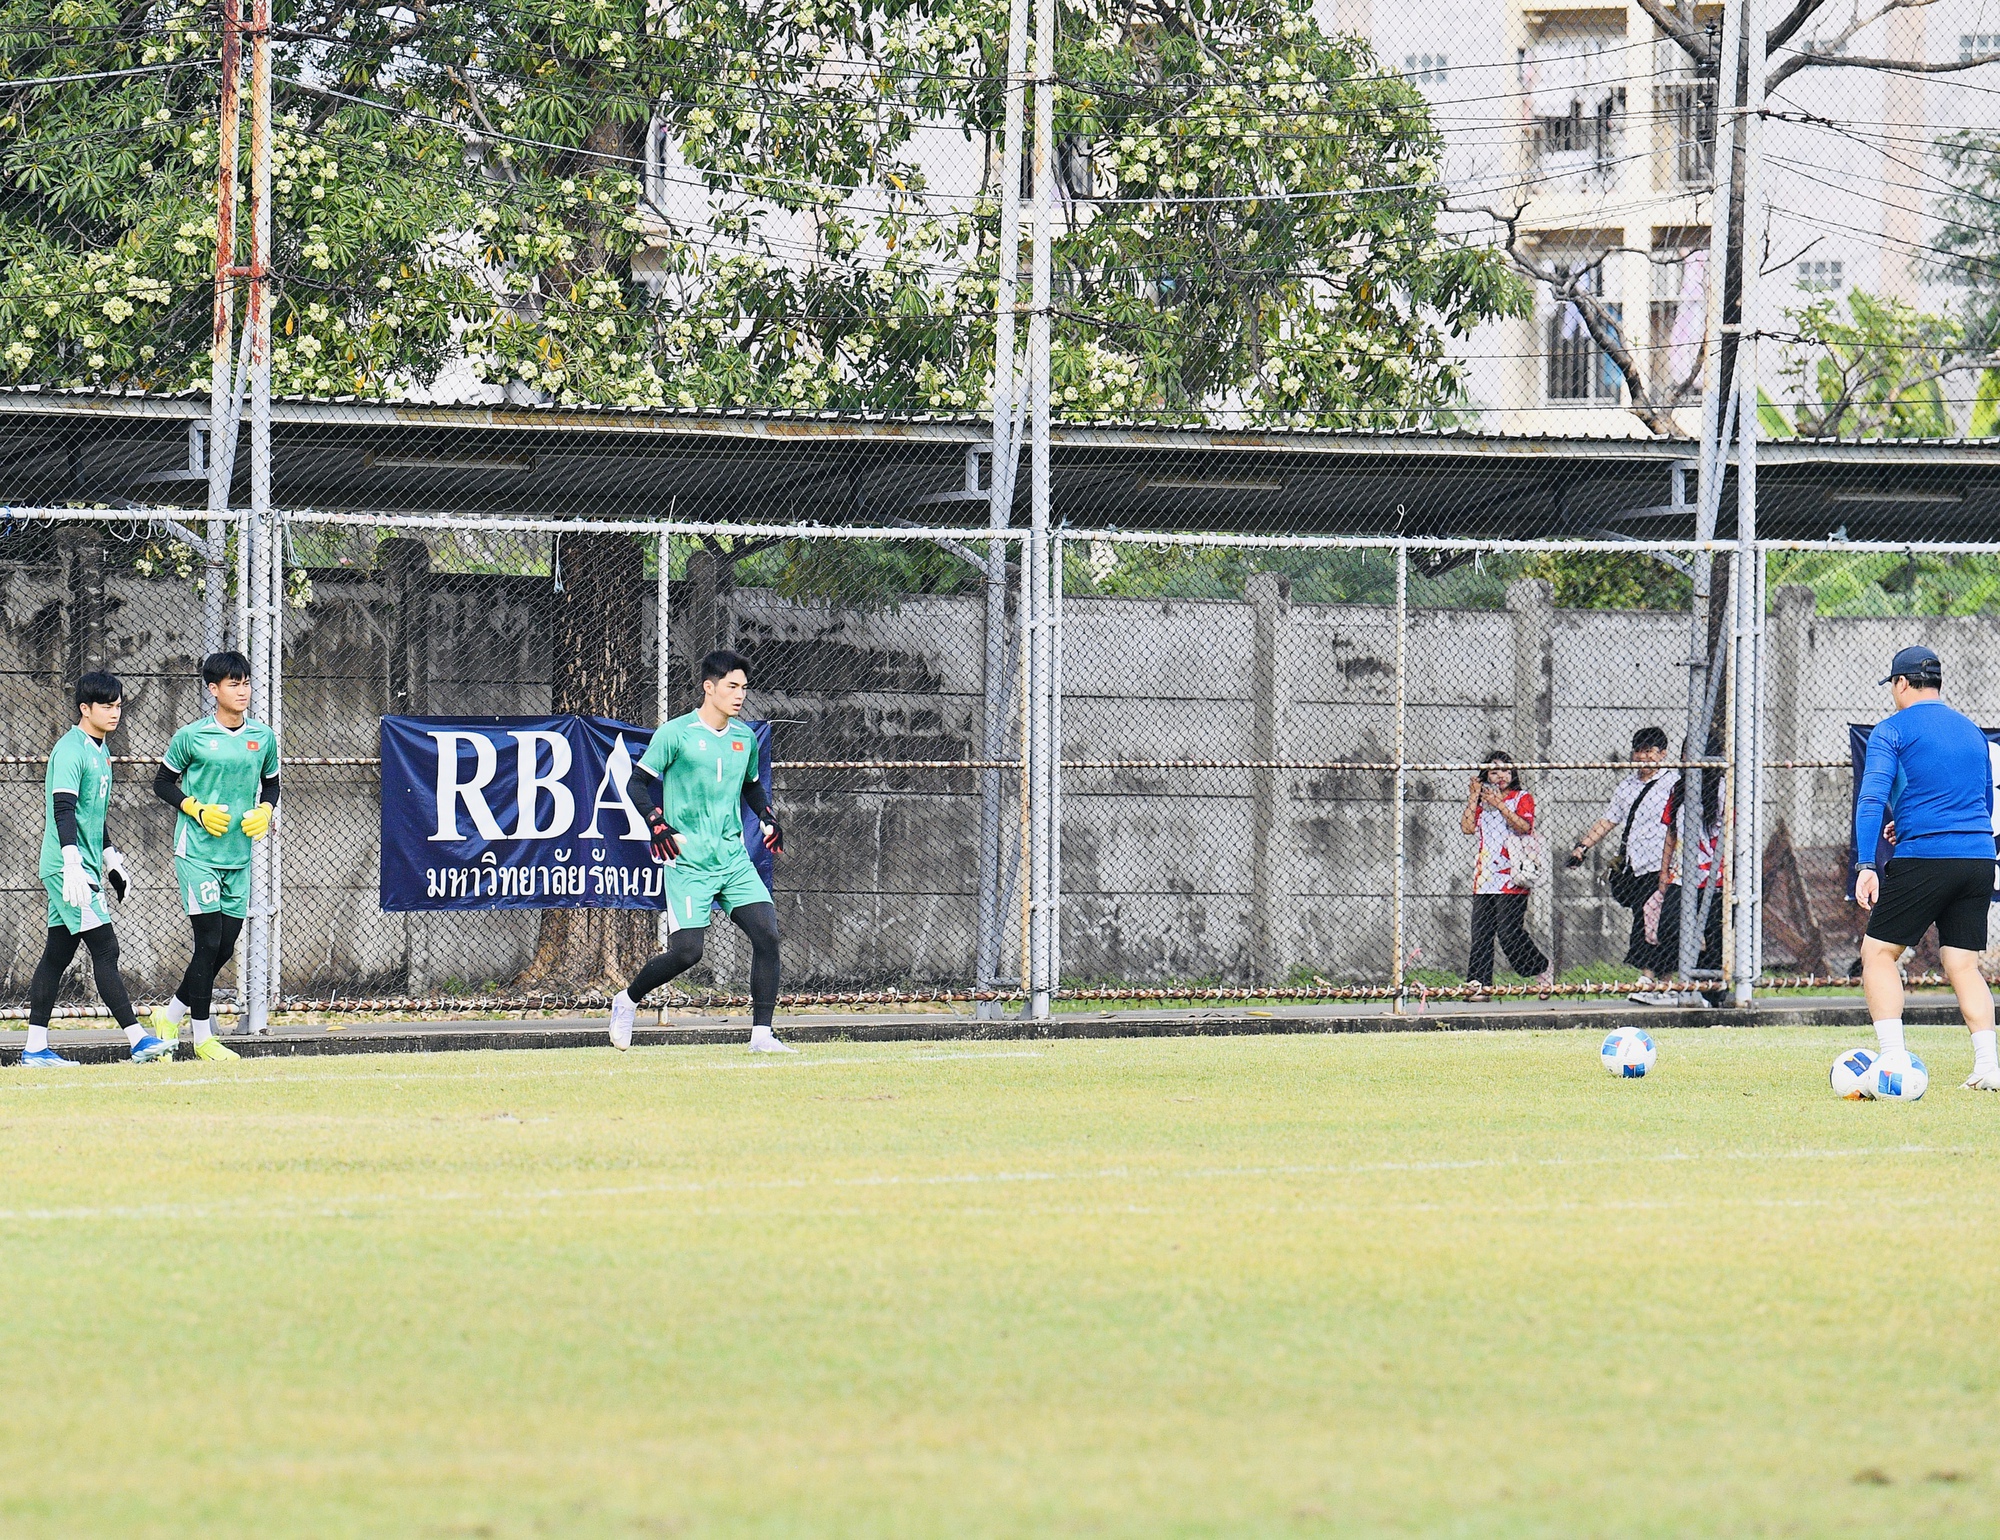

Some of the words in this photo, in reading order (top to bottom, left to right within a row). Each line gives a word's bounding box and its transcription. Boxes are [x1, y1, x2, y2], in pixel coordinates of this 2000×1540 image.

[716, 757, 722, 783] 1
[427, 731, 651, 841] RBA
[685, 895, 692, 919] 1
